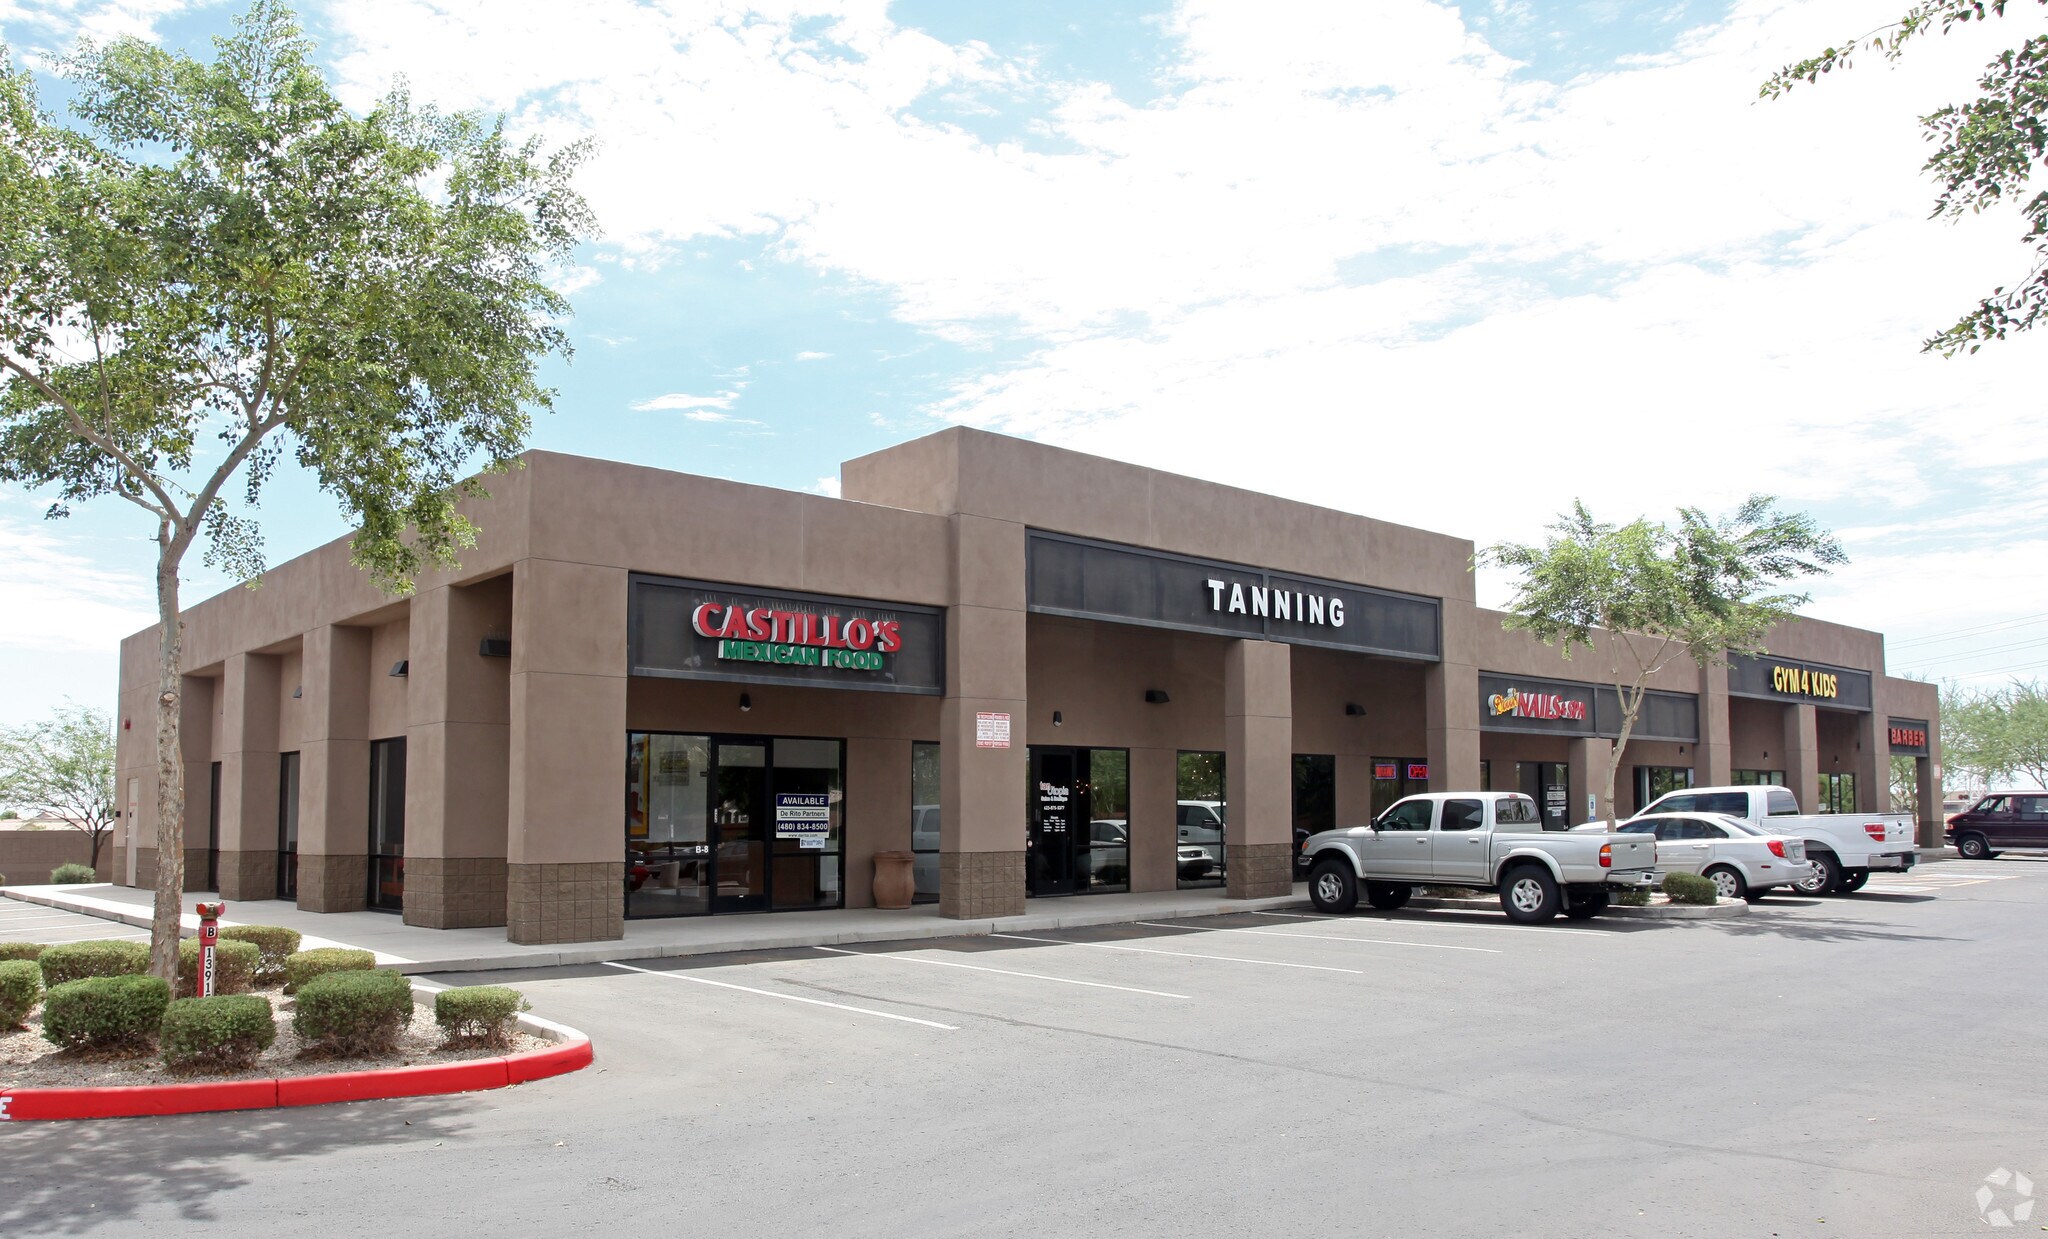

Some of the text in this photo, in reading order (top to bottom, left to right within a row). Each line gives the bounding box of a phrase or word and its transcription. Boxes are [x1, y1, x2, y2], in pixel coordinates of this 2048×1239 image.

[1207, 579, 1344, 627] TANNING
[692, 602, 902, 652] CASTILLO'S
[718, 640, 884, 670] MEXICAN FOOD
[1773, 666, 1838, 698] GYM 4 KIDS
[1514, 692, 1563, 719] NAILS
[1567, 700, 1587, 720] SPA
[1891, 727, 1925, 747] BARBER
[782, 797, 824, 805] AVAILABLE
[695, 845, 709, 854] B-8
[207, 927, 215, 937] B
